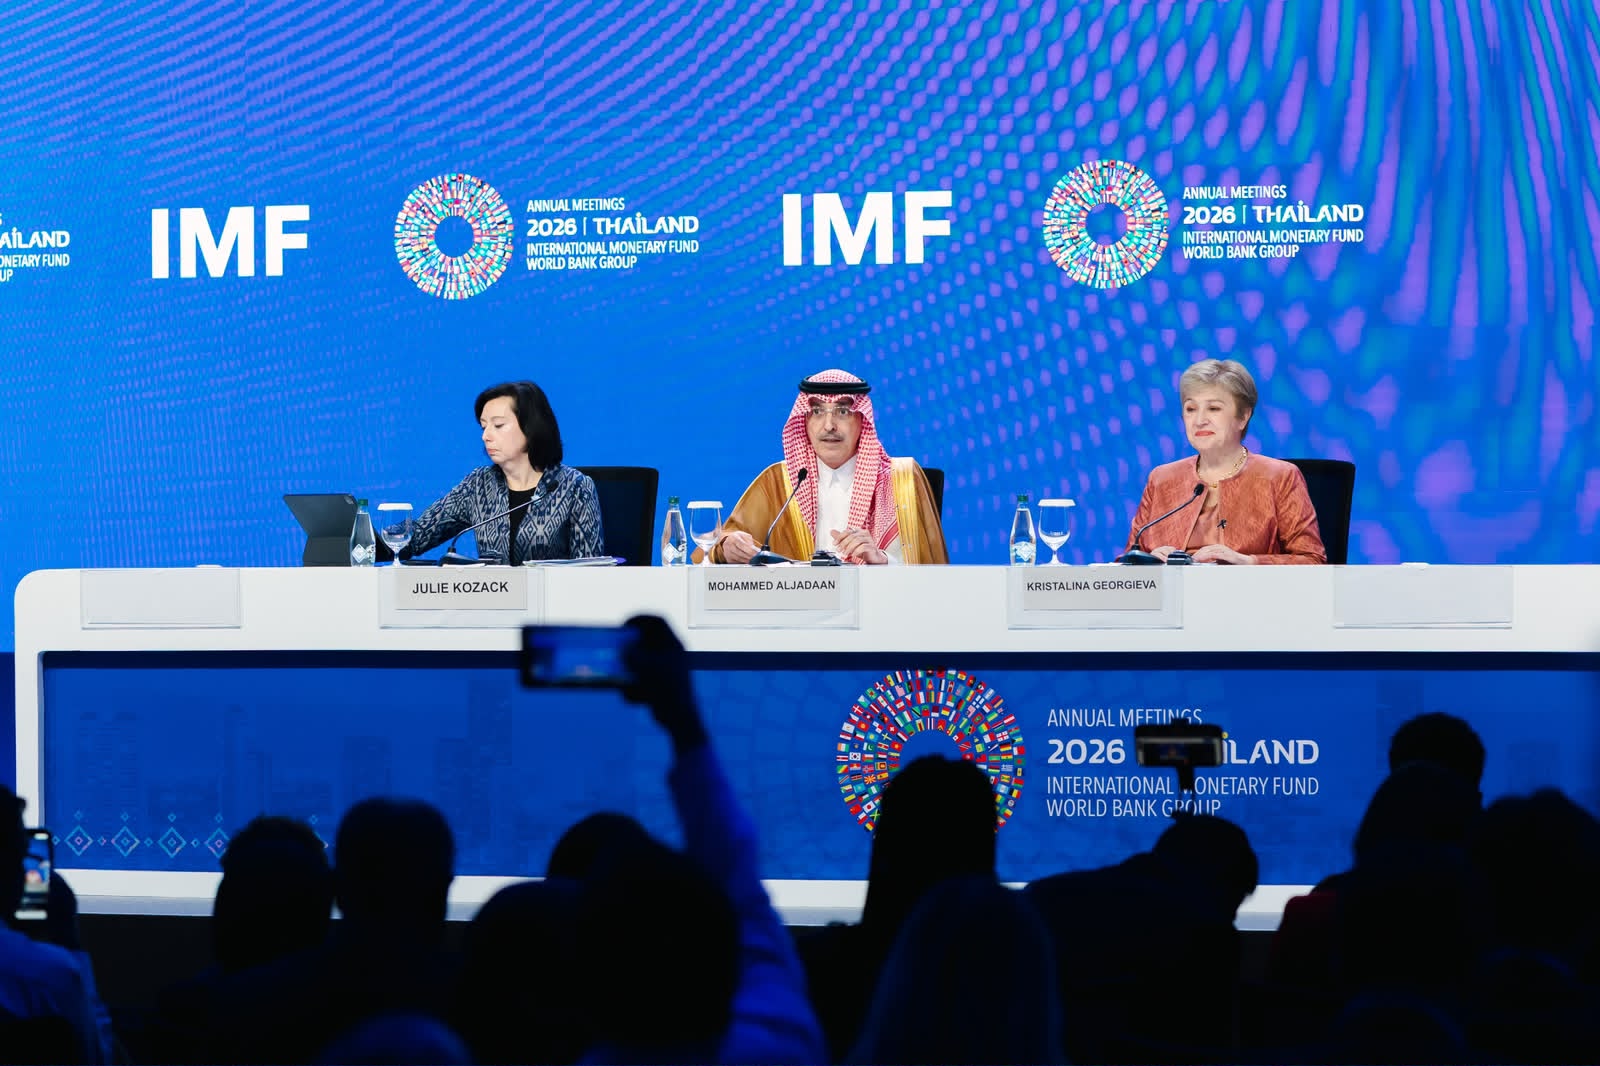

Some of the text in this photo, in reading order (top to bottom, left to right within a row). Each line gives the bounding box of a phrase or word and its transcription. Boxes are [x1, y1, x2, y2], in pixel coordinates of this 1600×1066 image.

[1183, 185, 1287, 200] ANNUAL MEETINGS
[527, 197, 625, 213] ANNUAL MEETINGS
[1183, 200, 1364, 224] 2026 THAILAND
[527, 212, 699, 236] 2026 THAILAND
[783, 190, 953, 266] IMF
[0, 227, 70, 249] AILAND
[151, 205, 310, 279] IMF
[1183, 228, 1364, 244] INTERNATIONAL MONETARY FUND
[527, 239, 699, 256] INTERNATIONAL MONETARY FUND
[1182, 244, 1300, 259] WORLD BANK GROUP
[0, 253, 70, 268] ONETARY FUND
[526, 255, 637, 270] WORLD BANK GROUP
[412, 581, 509, 594] JULIE KOZACK
[708, 580, 836, 591] MOHAMMED ALJADAAN
[1027, 580, 1157, 591] KRISTALINA GEORGIEVA
[1047, 708, 1116, 728] ANNUAL
[1047, 731, 1320, 765] 2026 ILAND
[1047, 776, 1320, 795] INTERNATIONAL ONETARY FUND
[1046, 799, 1108, 817] WORLD
[1112, 799, 1158, 817] BANK
